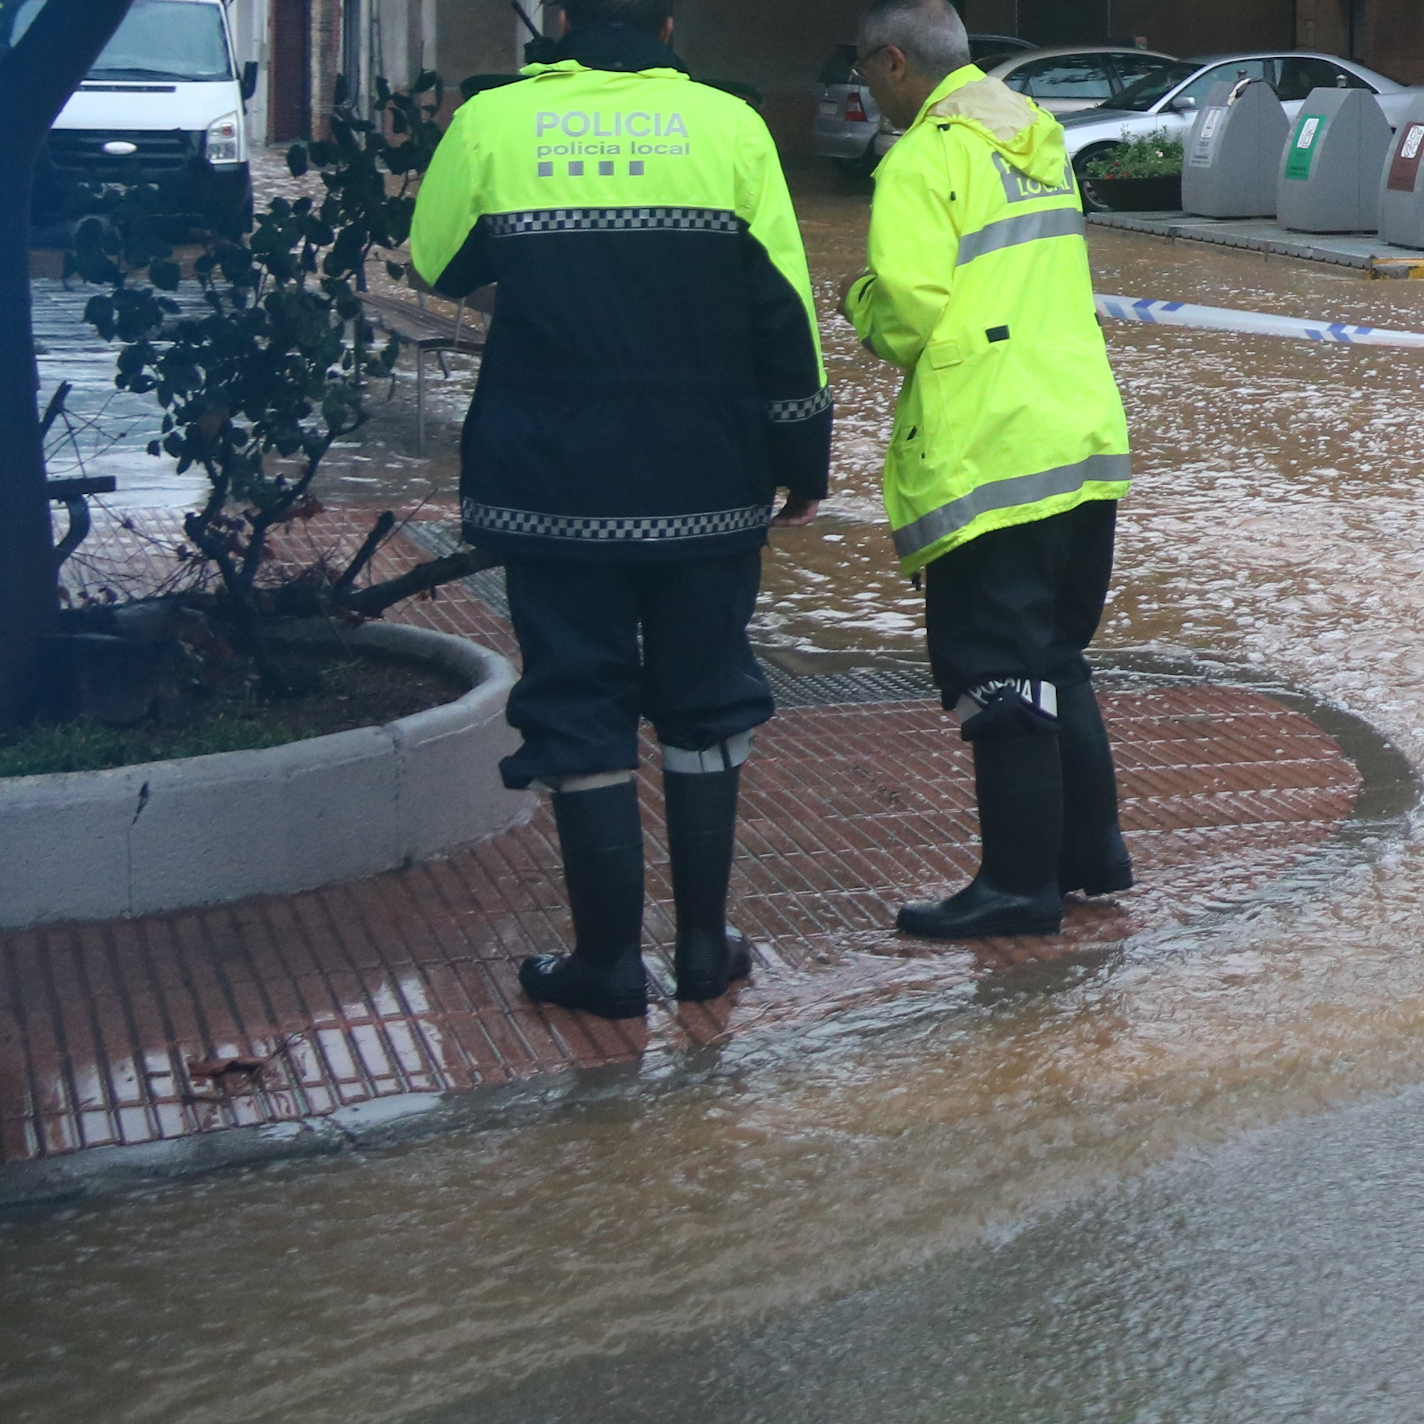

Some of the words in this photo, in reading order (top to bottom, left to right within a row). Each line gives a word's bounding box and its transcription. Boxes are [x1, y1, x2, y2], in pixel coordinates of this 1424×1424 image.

[537, 111, 689, 137] POLICIA
[537, 141, 621, 158] policia
[631, 141, 690, 155] local
